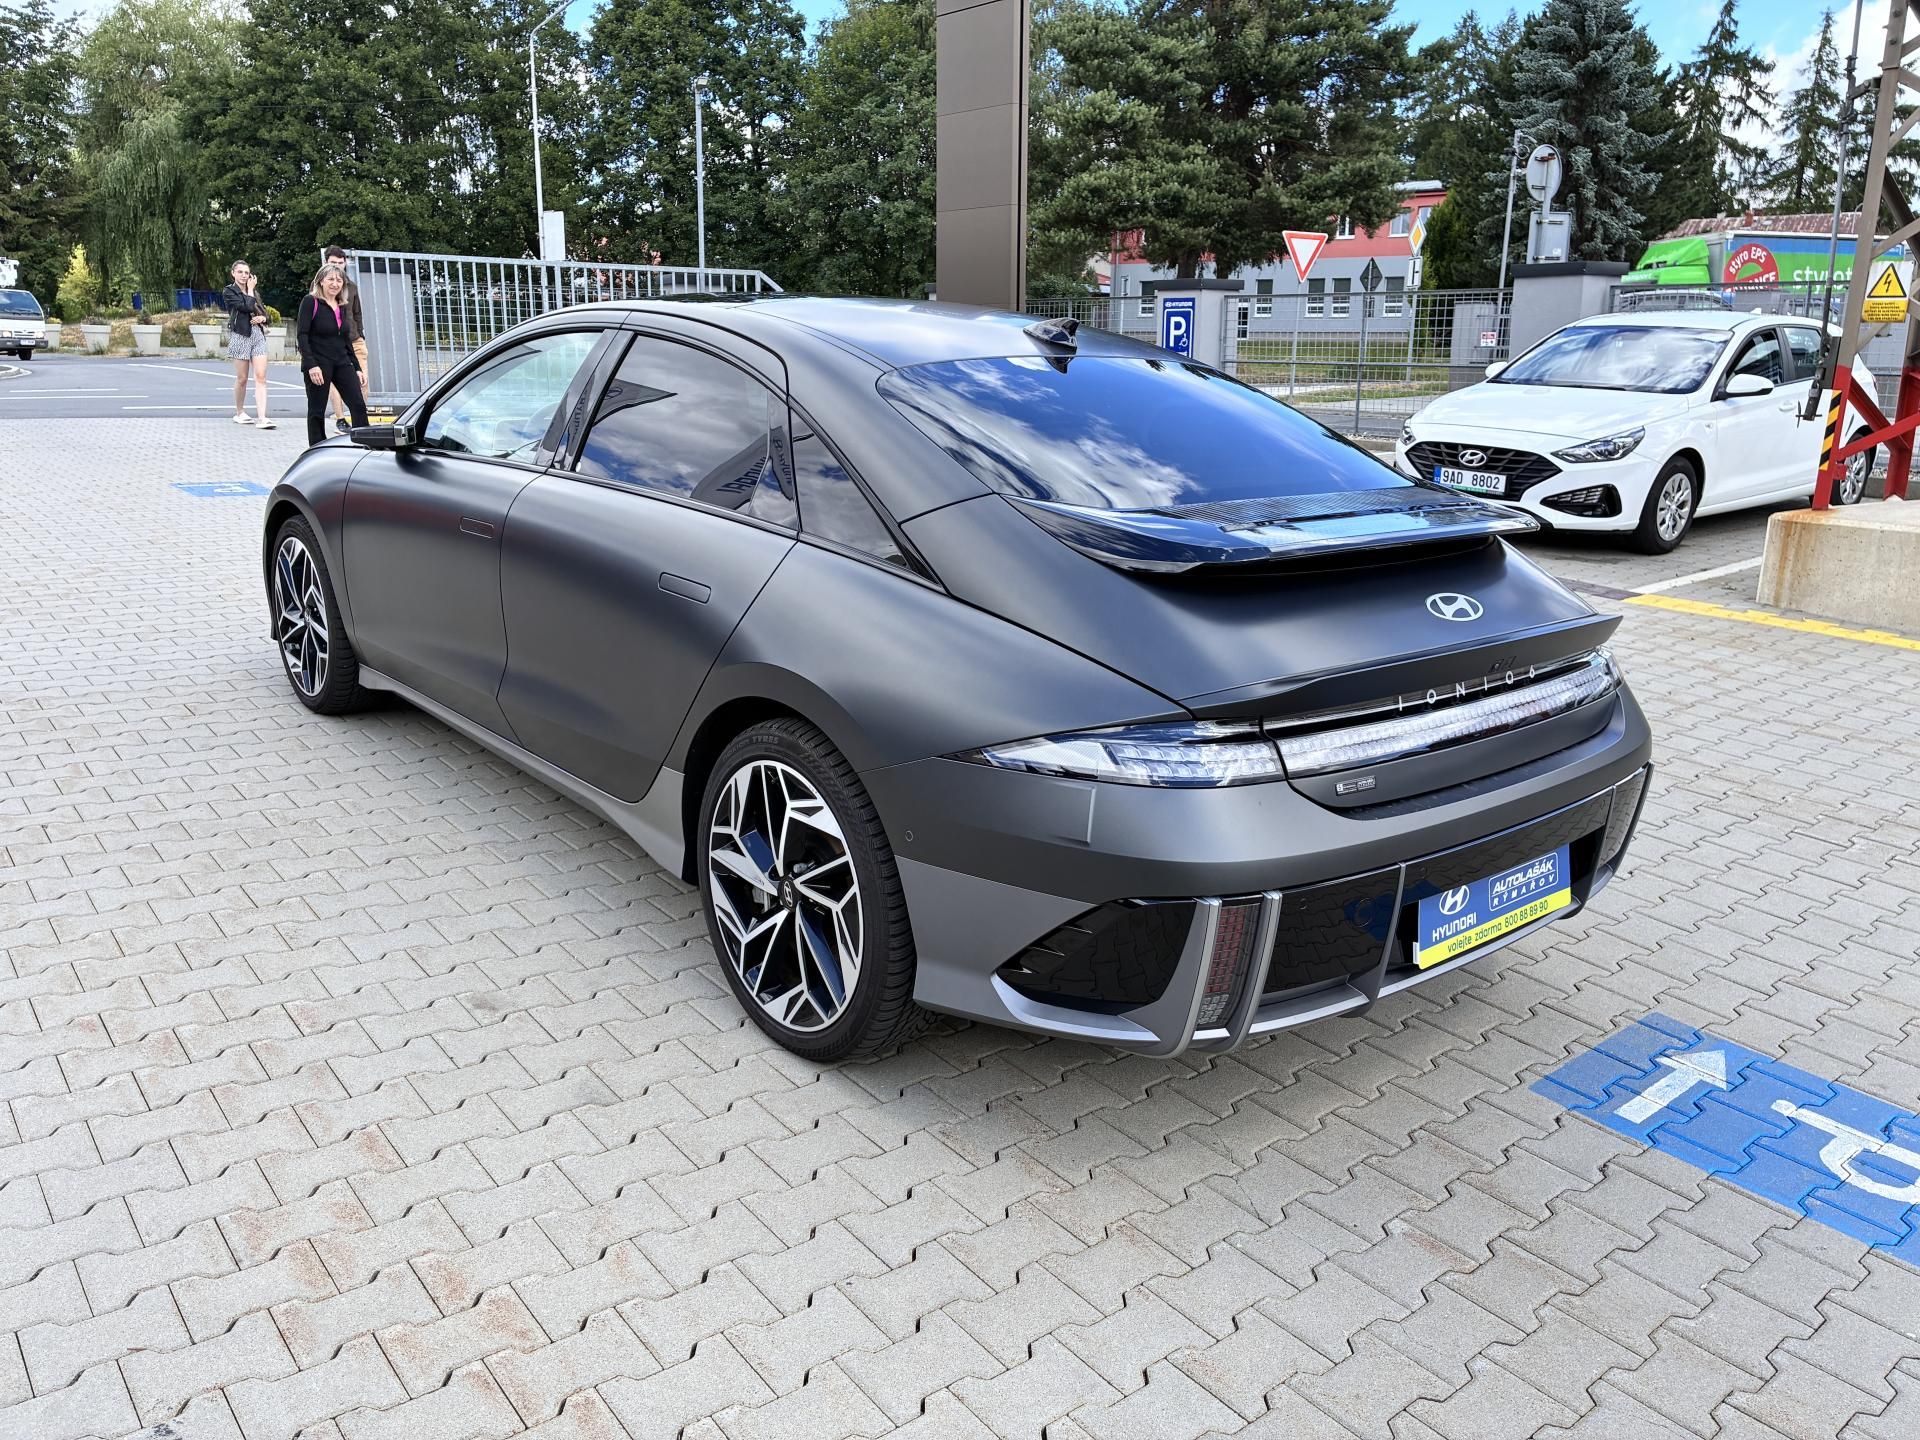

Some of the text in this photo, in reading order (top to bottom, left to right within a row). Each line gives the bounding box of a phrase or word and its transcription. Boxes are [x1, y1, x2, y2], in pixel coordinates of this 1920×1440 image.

[1751, 246, 1767, 263] EPS
[1170, 316, 1186, 347] P
[1442, 470, 1500, 490] 9AD 8802
[1492, 859, 1553, 894] AUTOLAŠÁK
[1493, 873, 1555, 907] RÝMAŘOV
[1432, 911, 1477, 942] HYUNDAI
[1447, 899, 1548, 953] volejte zdarma 800 88 89 90
